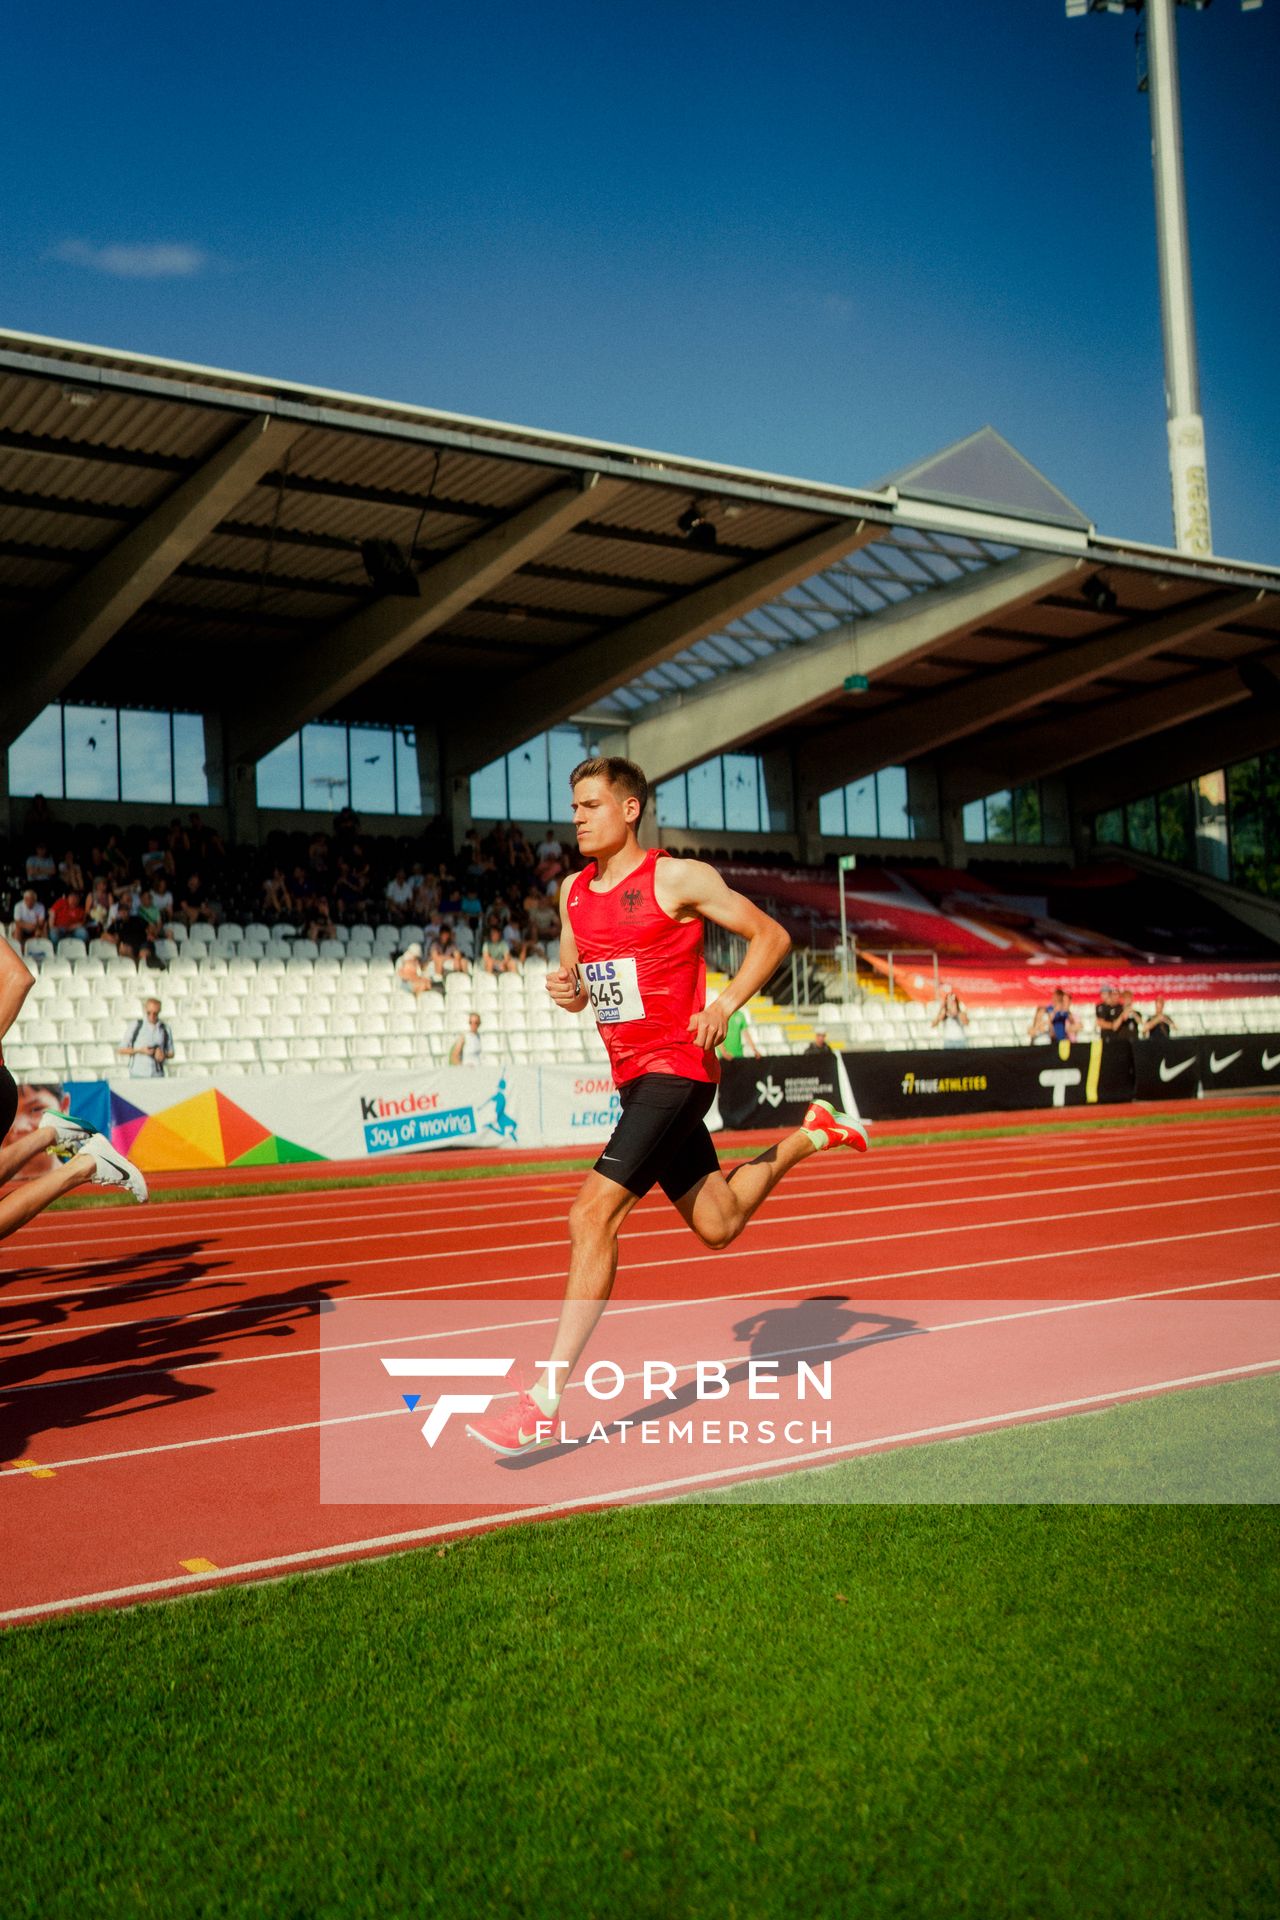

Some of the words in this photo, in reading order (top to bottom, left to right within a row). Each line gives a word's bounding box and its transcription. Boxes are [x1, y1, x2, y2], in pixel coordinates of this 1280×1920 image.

[585, 961, 616, 982] GLS
[589, 981, 624, 1007] 645
[360, 1092, 439, 1120] kinder
[369, 1126, 399, 1147] Joy
[401, 1118, 416, 1141] of
[419, 1113, 472, 1137] moving
